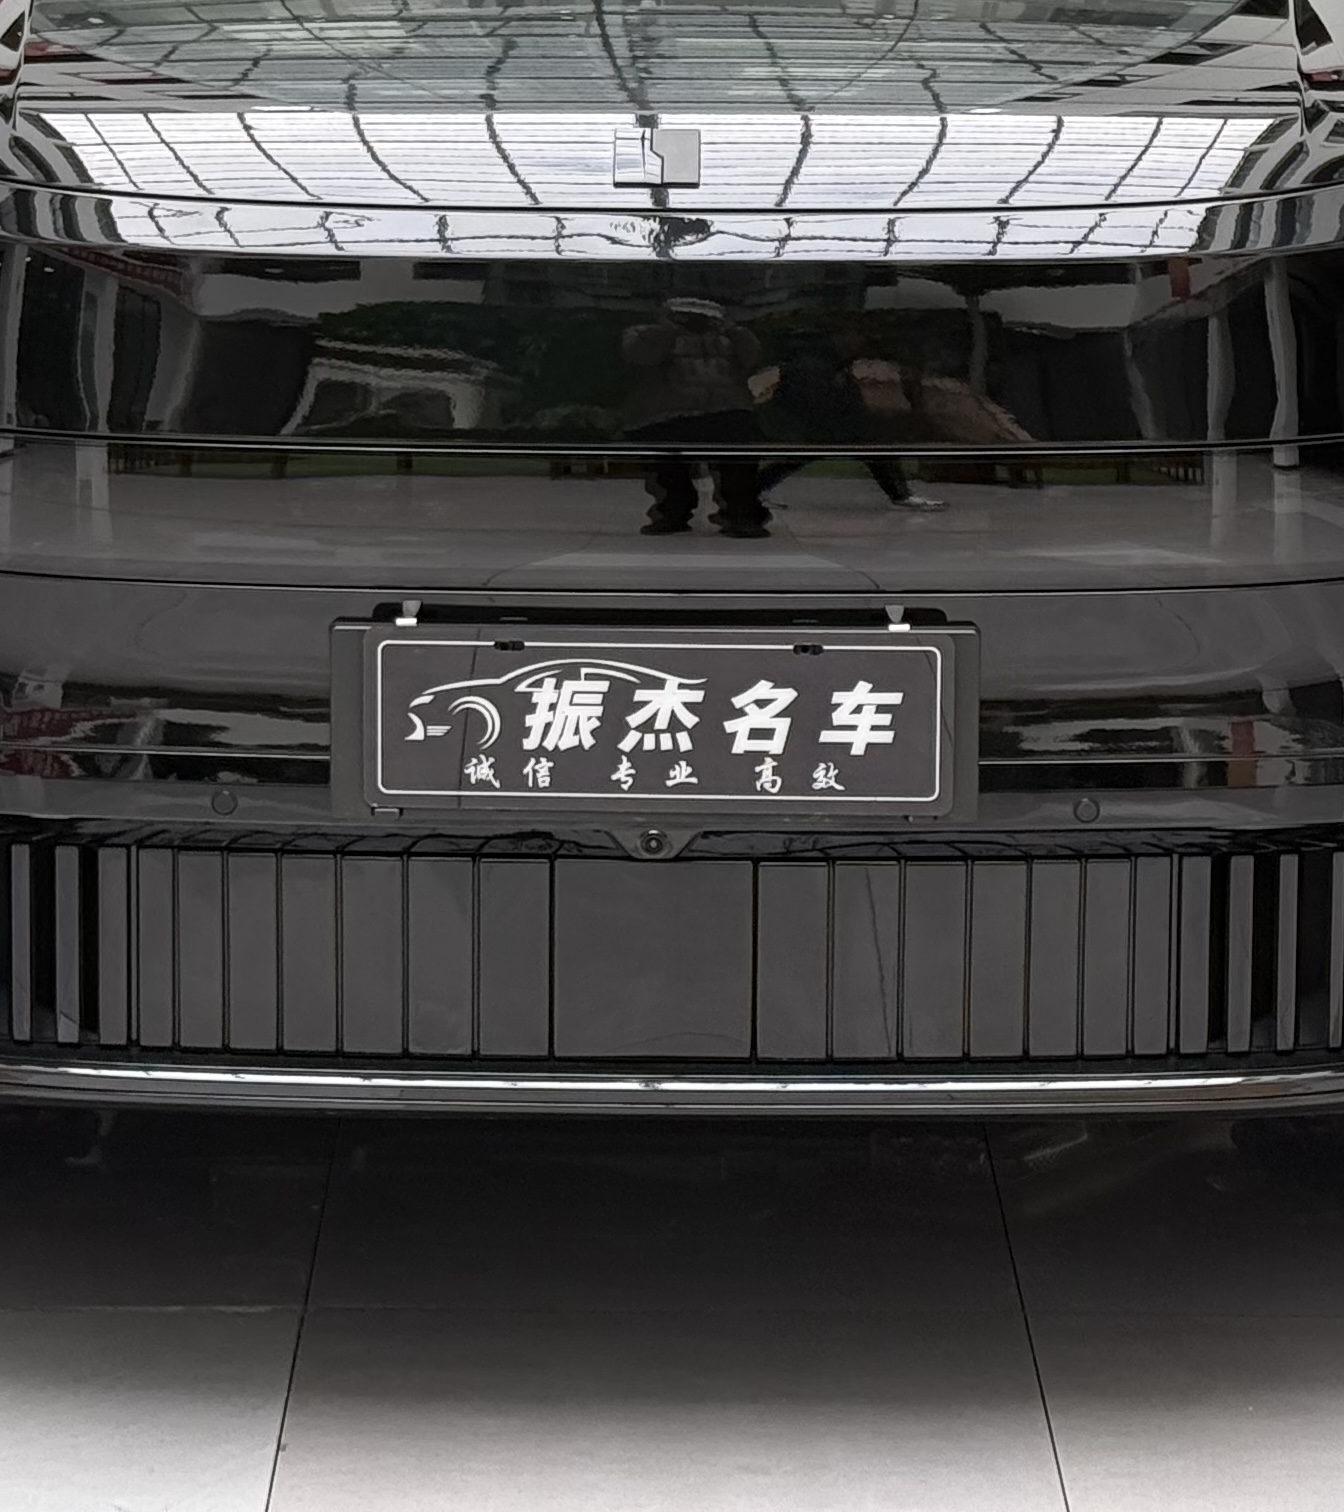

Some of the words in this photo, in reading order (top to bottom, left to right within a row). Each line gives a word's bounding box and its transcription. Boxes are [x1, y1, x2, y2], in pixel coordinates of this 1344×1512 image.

[515, 678, 905, 756] 振杰名车
[464, 754, 555, 790] 诚信
[610, 754, 700, 791] 专业
[754, 756, 847, 794] 高效
